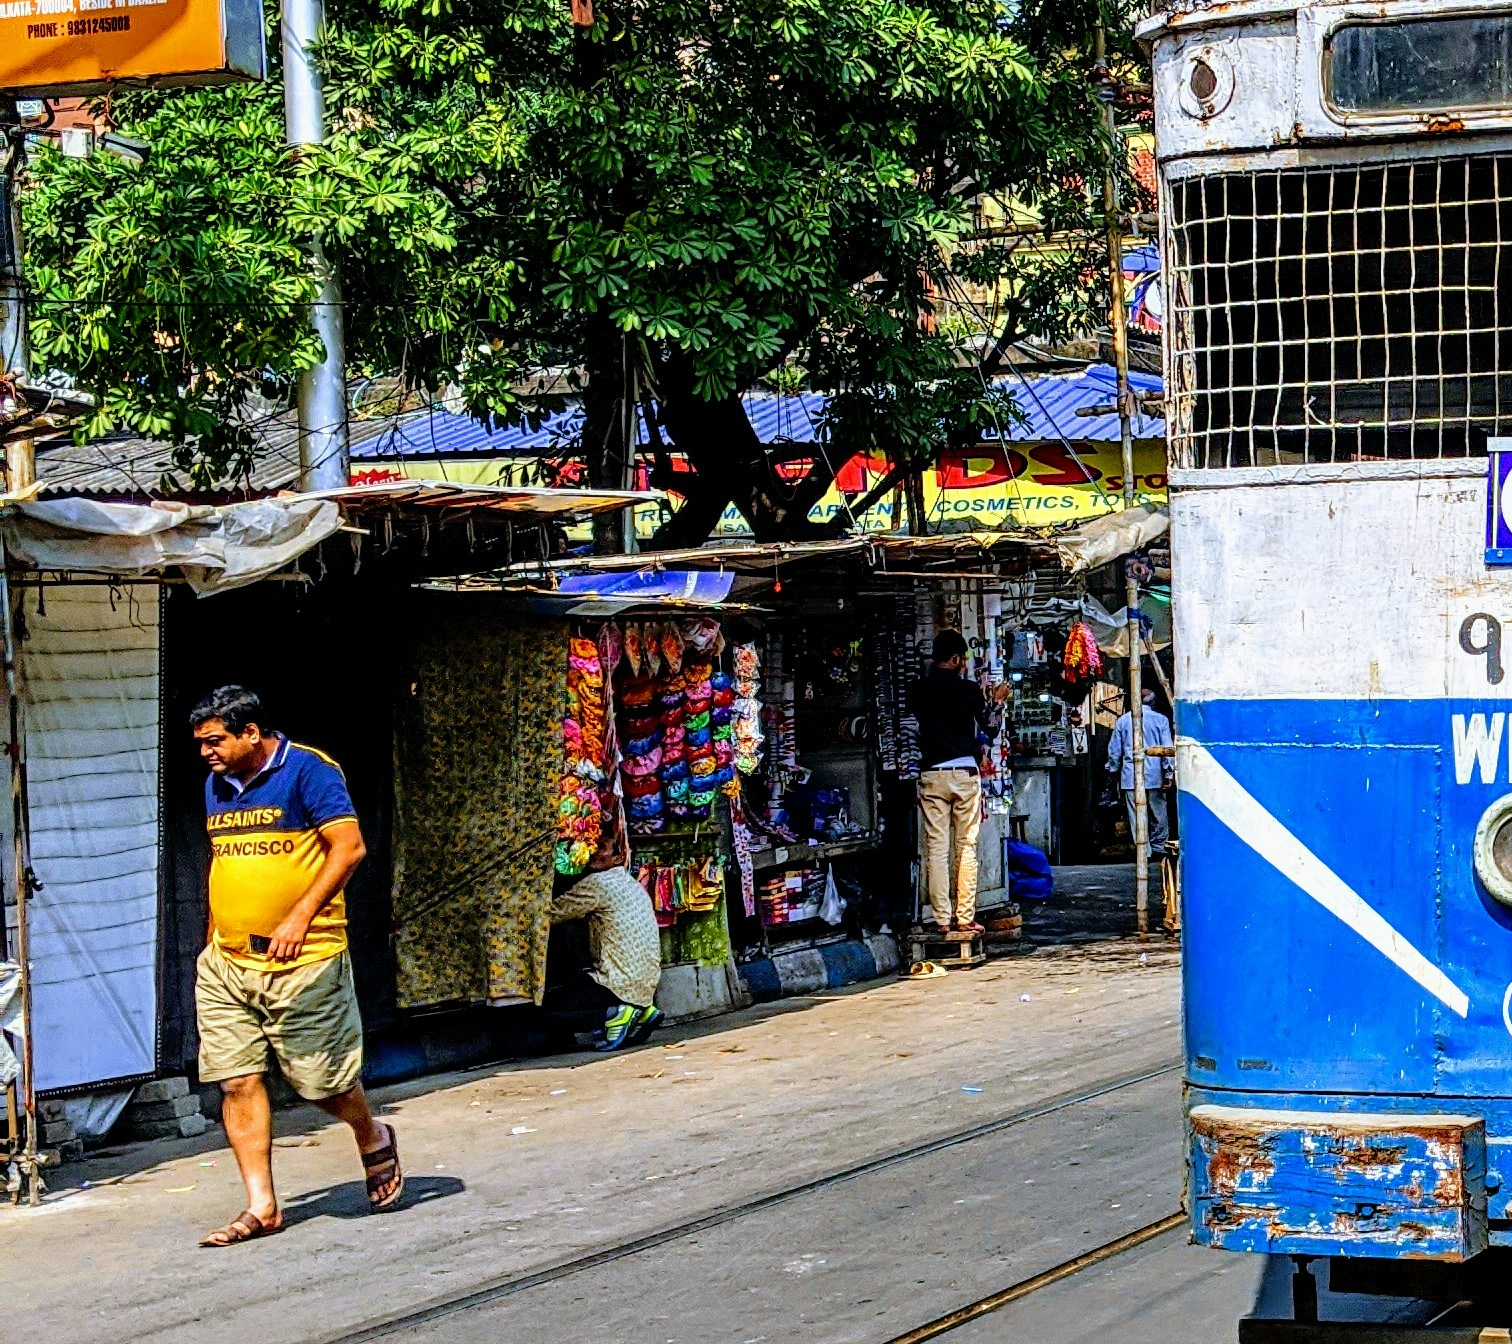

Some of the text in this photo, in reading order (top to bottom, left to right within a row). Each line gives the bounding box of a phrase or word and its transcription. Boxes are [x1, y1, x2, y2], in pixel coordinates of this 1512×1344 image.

[28, 22, 58, 39] PHONE
[936, 494, 1081, 514] COSMETICS,
[1090, 492, 1151, 508] TOS
[211, 839, 295, 857] RANCISCO
